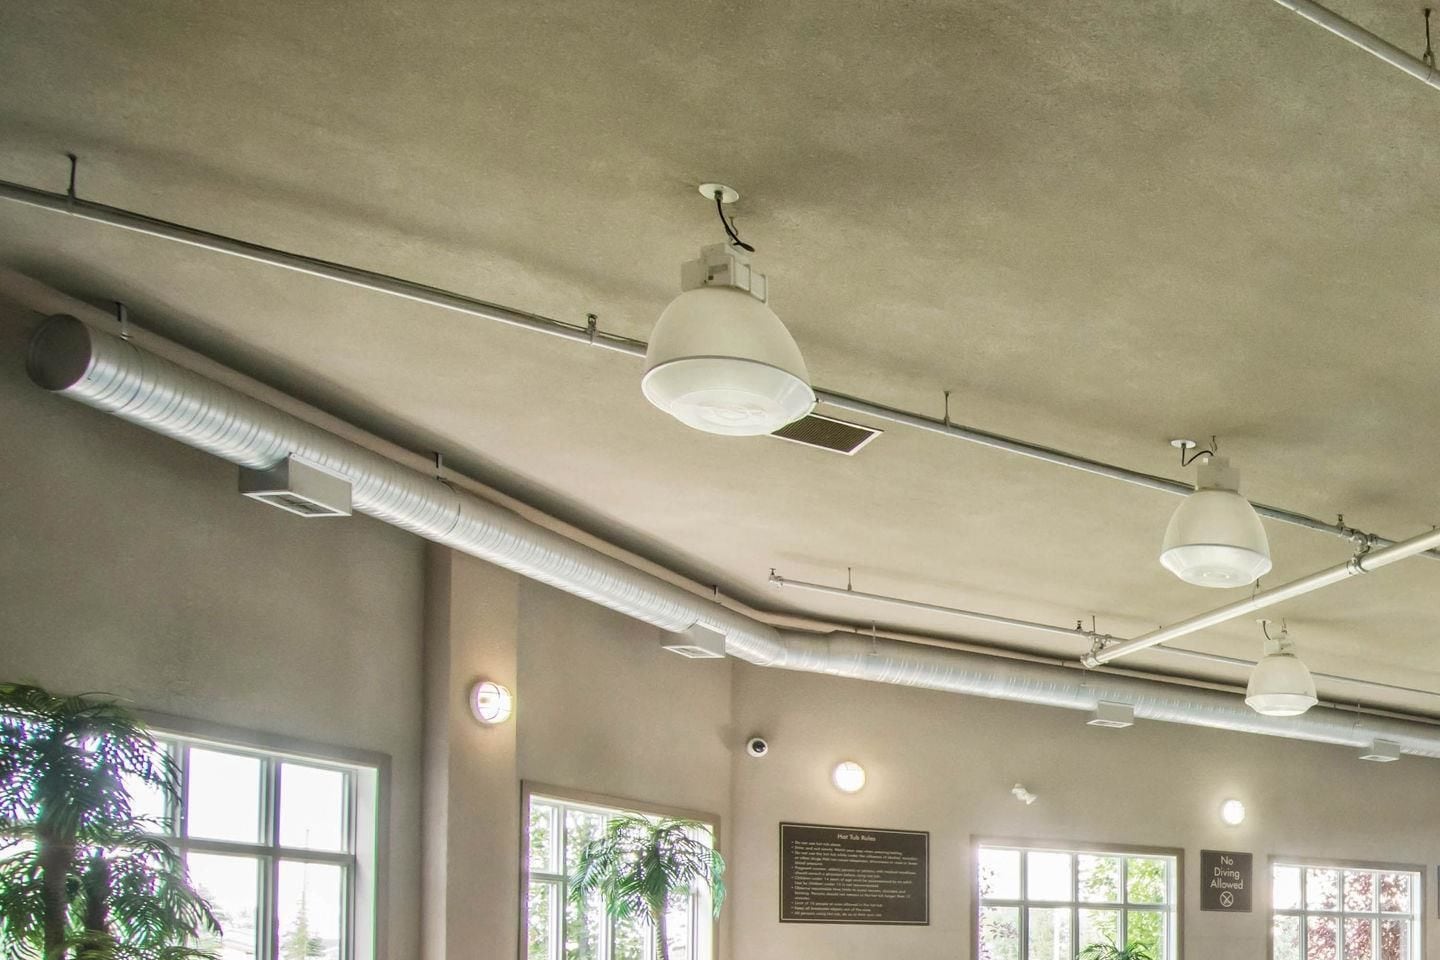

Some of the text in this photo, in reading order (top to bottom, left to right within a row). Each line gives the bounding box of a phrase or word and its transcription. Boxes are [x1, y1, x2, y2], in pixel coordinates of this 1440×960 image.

[861, 834, 876, 842] Rules
[1220, 855, 1234, 866] No
[1214, 866, 1240, 880] Diving
[1210, 877, 1244, 890] Allowed
